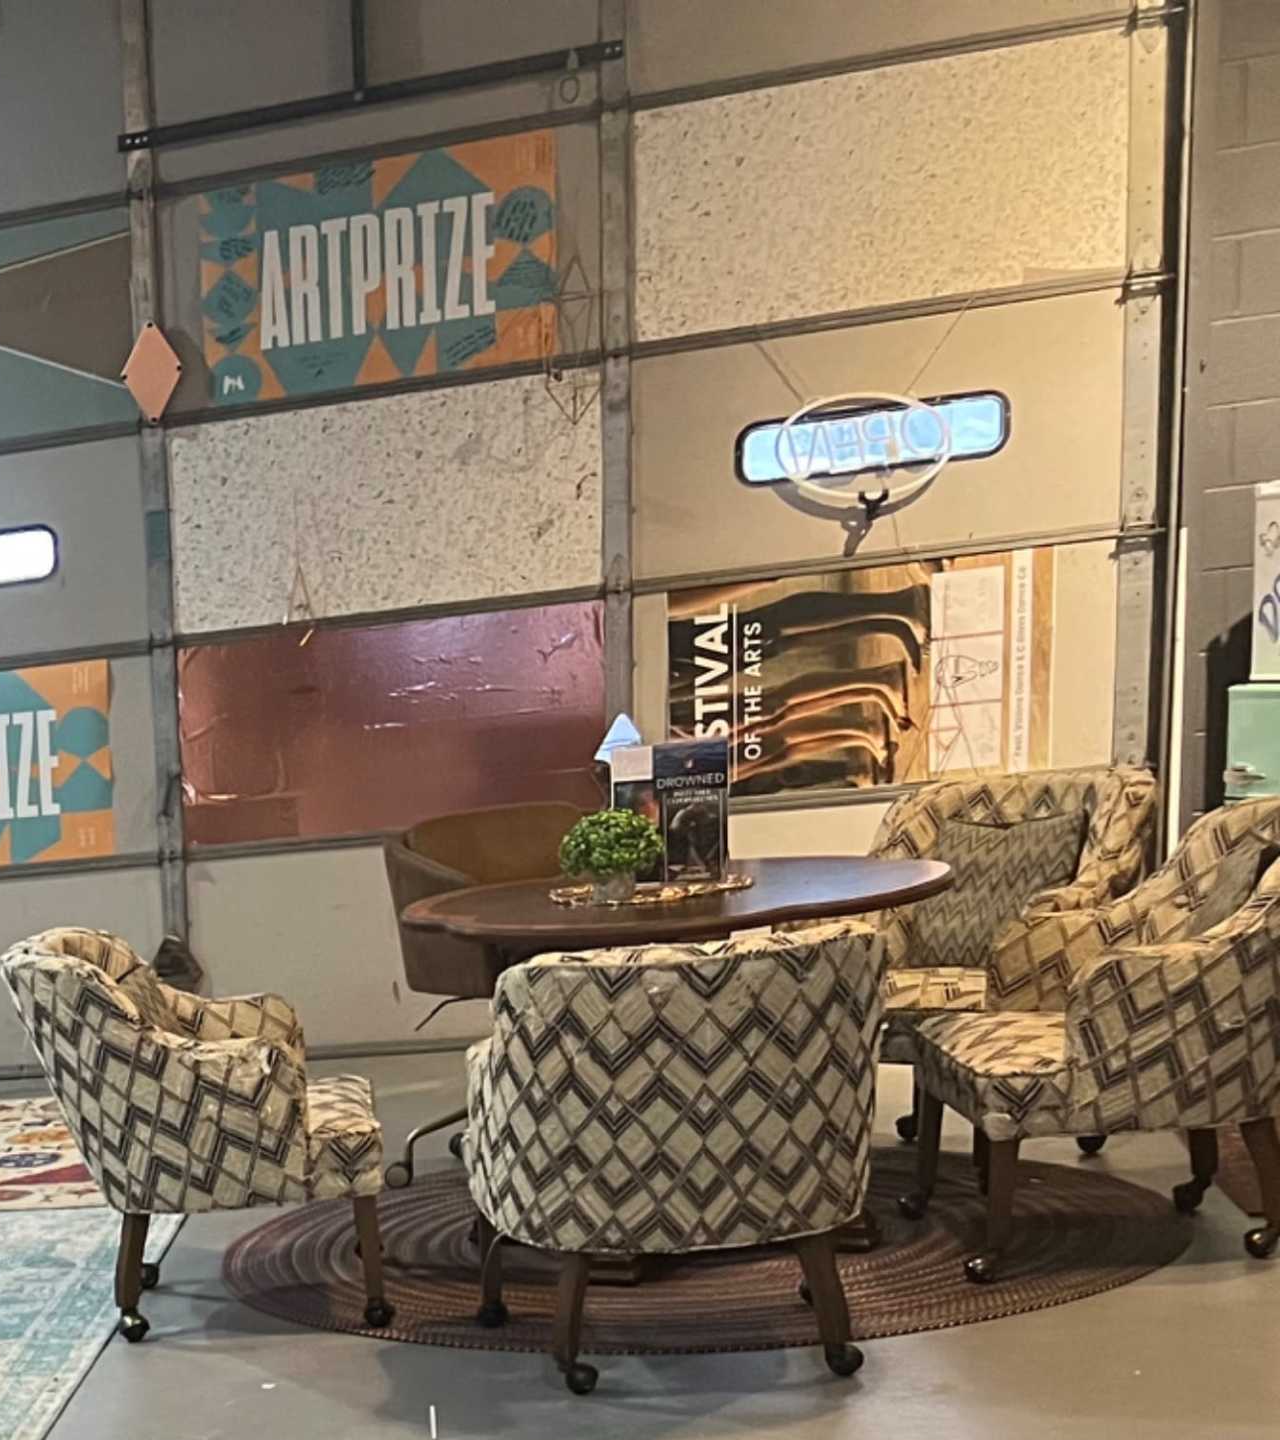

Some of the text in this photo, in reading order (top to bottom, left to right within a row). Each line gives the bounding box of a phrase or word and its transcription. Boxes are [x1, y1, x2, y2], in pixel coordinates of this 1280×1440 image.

[260, 191, 496, 351] ARTPRIZE
[694, 602, 729, 738] STIVAL
[744, 622, 762, 760] OF THE ARTS
[656, 772, 725, 790] DROWNED
